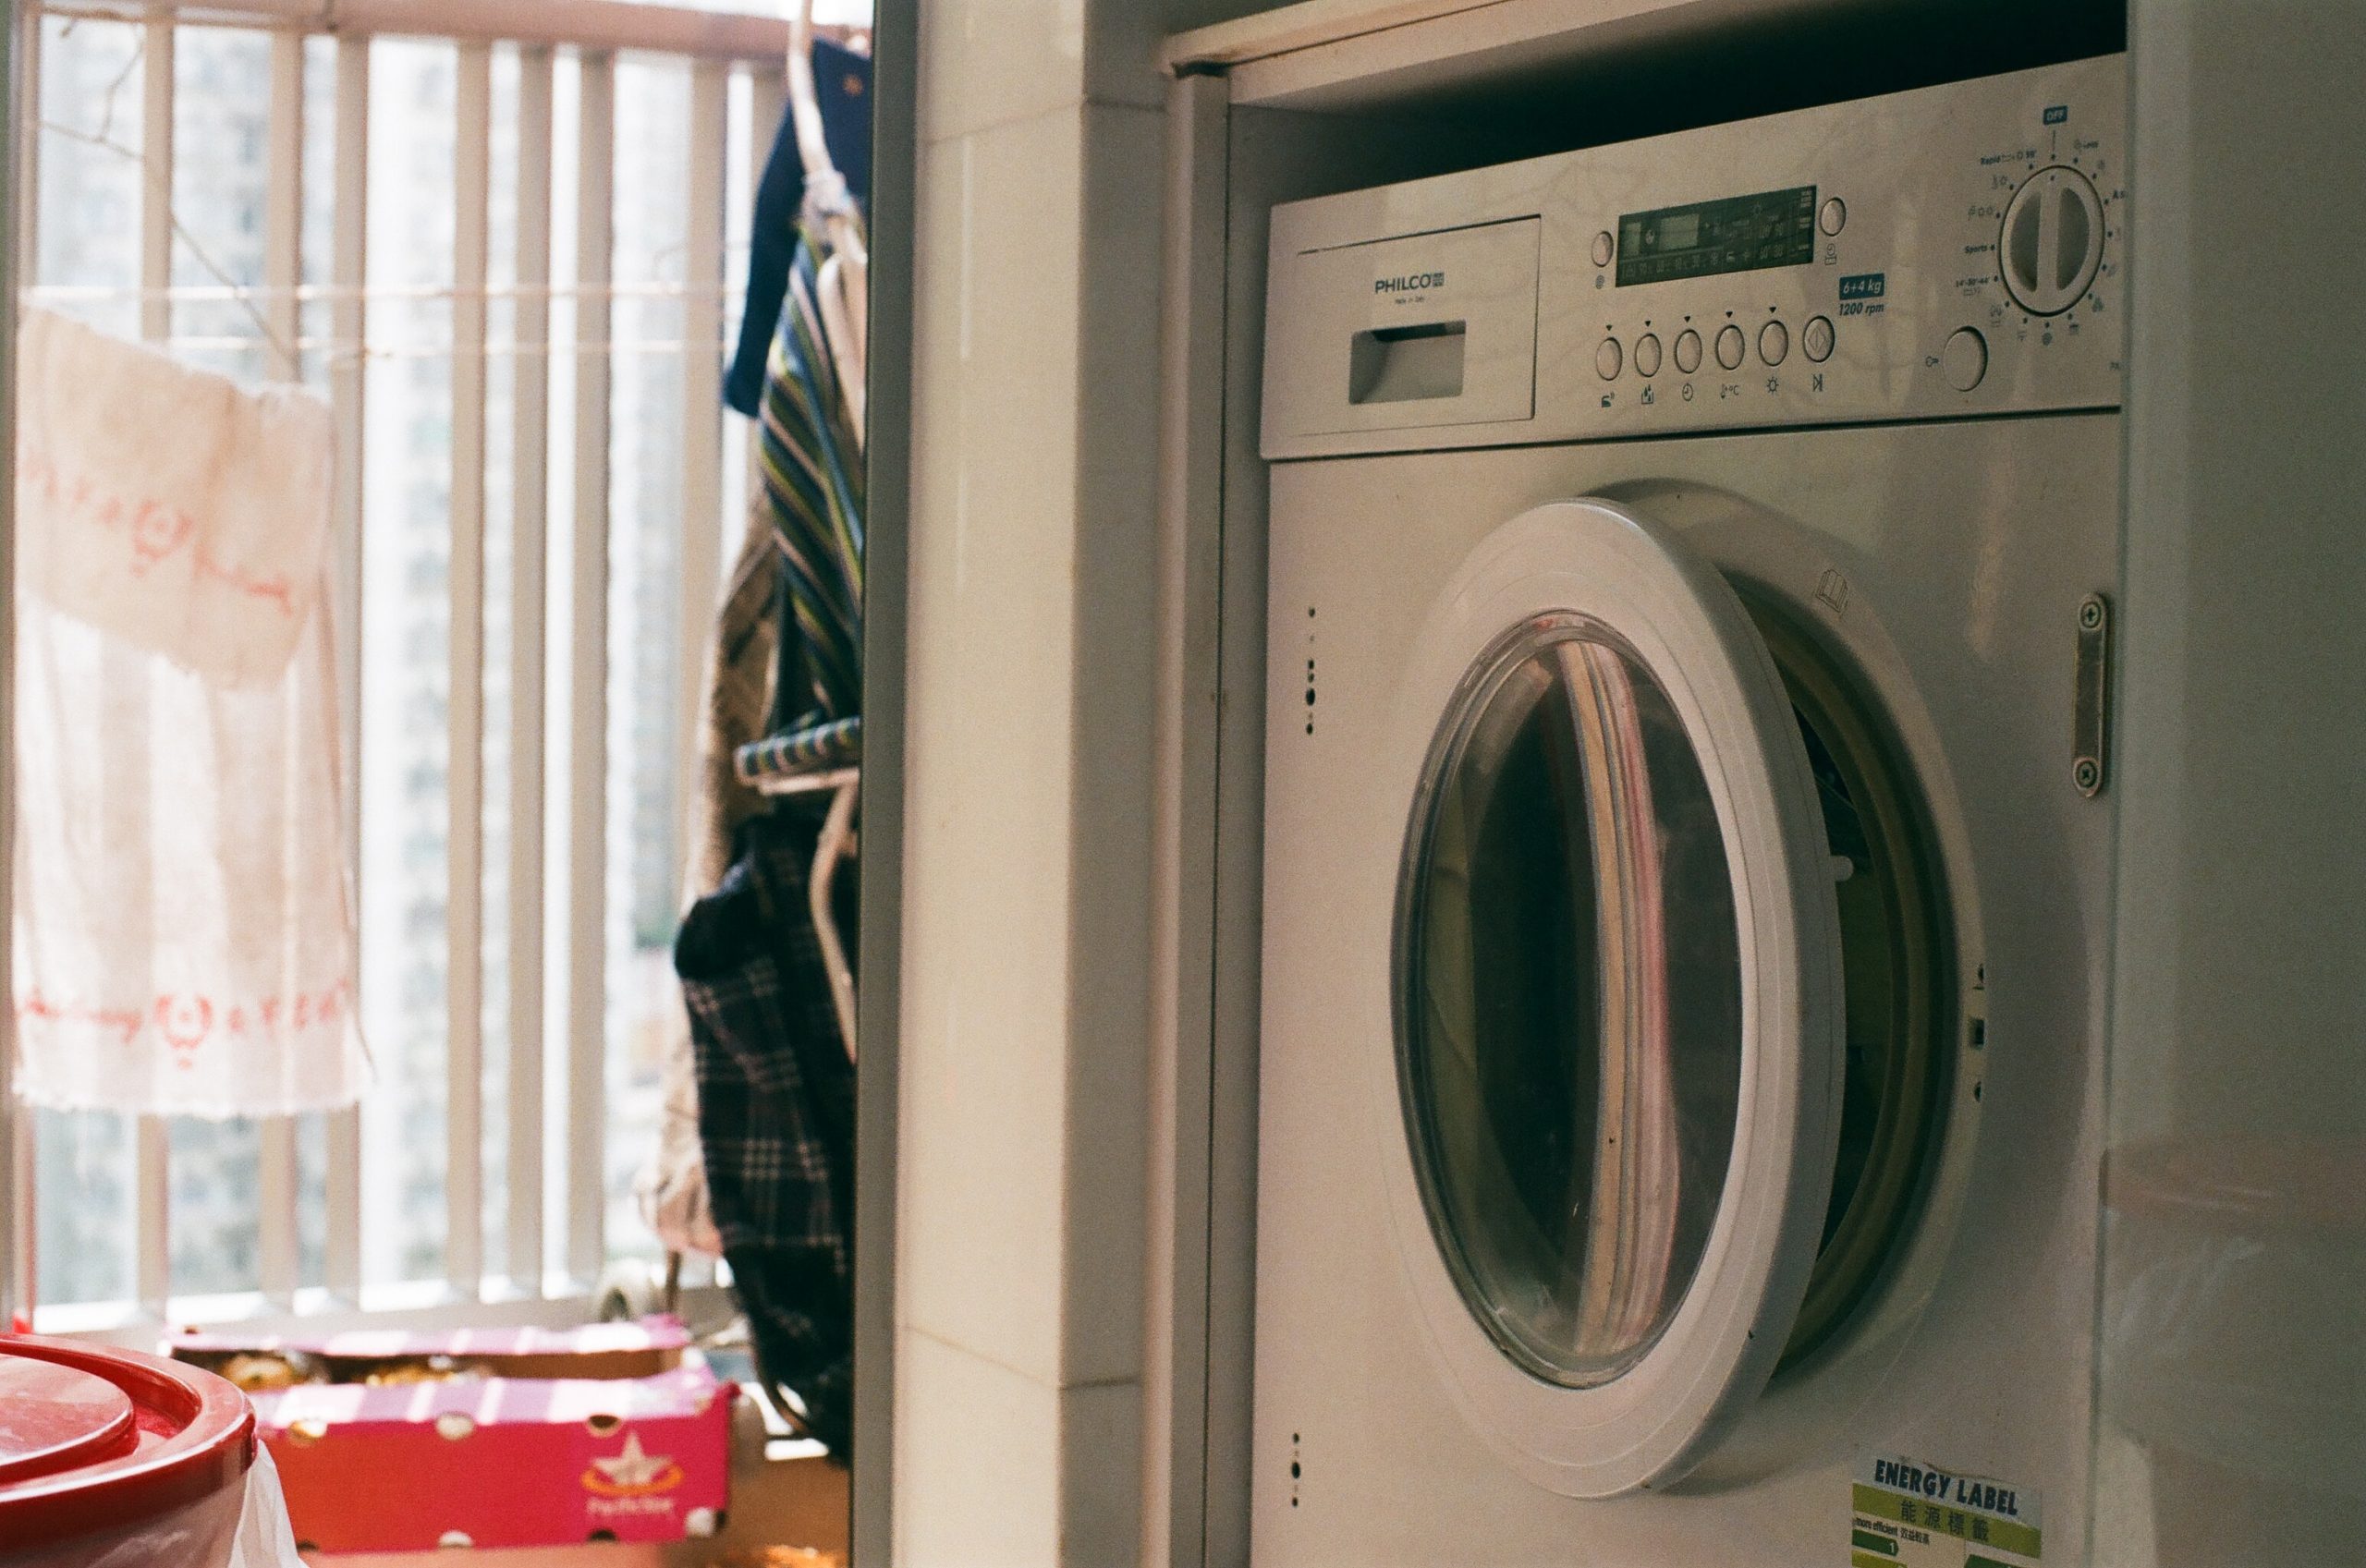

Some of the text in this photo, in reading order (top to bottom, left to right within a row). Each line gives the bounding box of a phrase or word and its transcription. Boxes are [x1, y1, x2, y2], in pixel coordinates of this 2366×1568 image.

[2045, 109, 2065, 122] OFF
[1374, 273, 1432, 294] PHILCO
[1843, 278, 1883, 294] 6+4 kg
[1839, 302, 1884, 316] 1200 rpm
[1874, 1459, 2018, 1516] ENERGY LABEL
